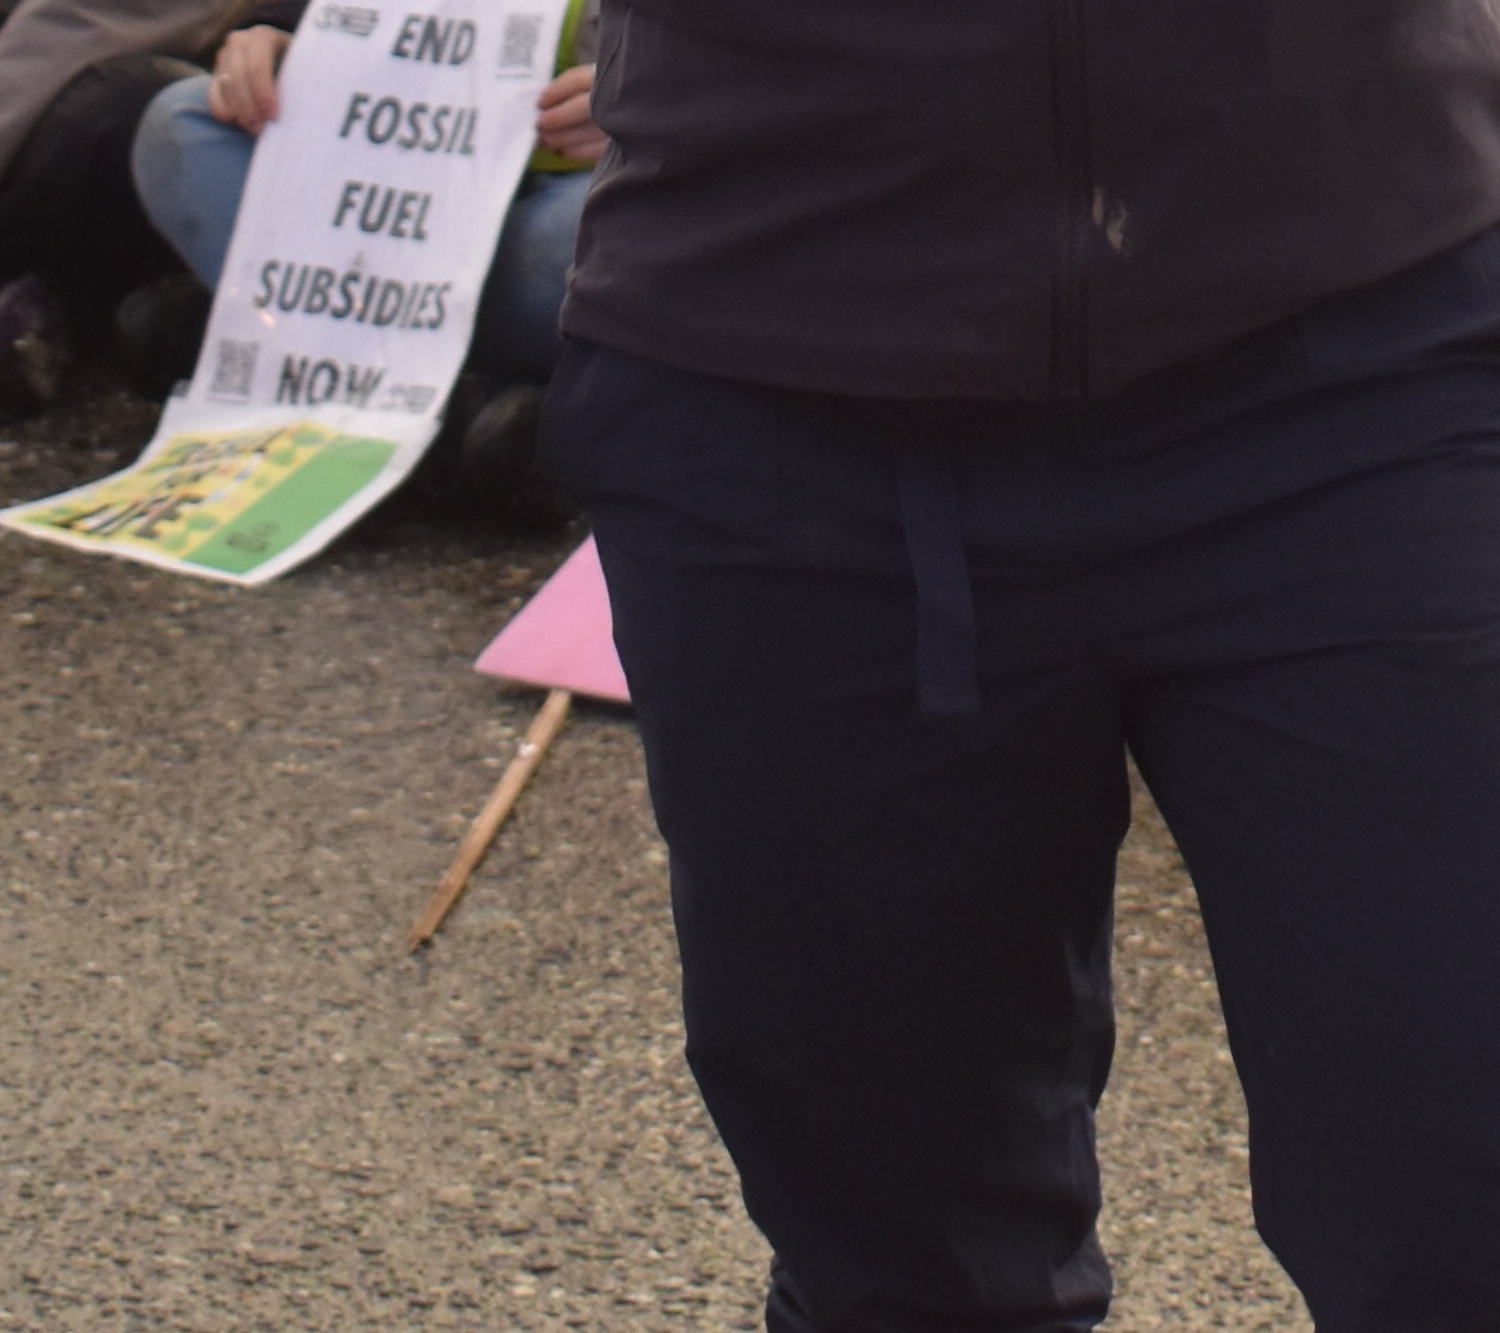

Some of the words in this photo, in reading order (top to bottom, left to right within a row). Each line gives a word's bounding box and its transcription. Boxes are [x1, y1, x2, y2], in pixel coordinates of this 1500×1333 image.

[390, 12, 479, 67] END
[338, 91, 480, 157] FOSSIL
[331, 180, 433, 242] FUEL
[252, 259, 455, 331] SUBSIDIES
[275, 355, 388, 411] NOW
